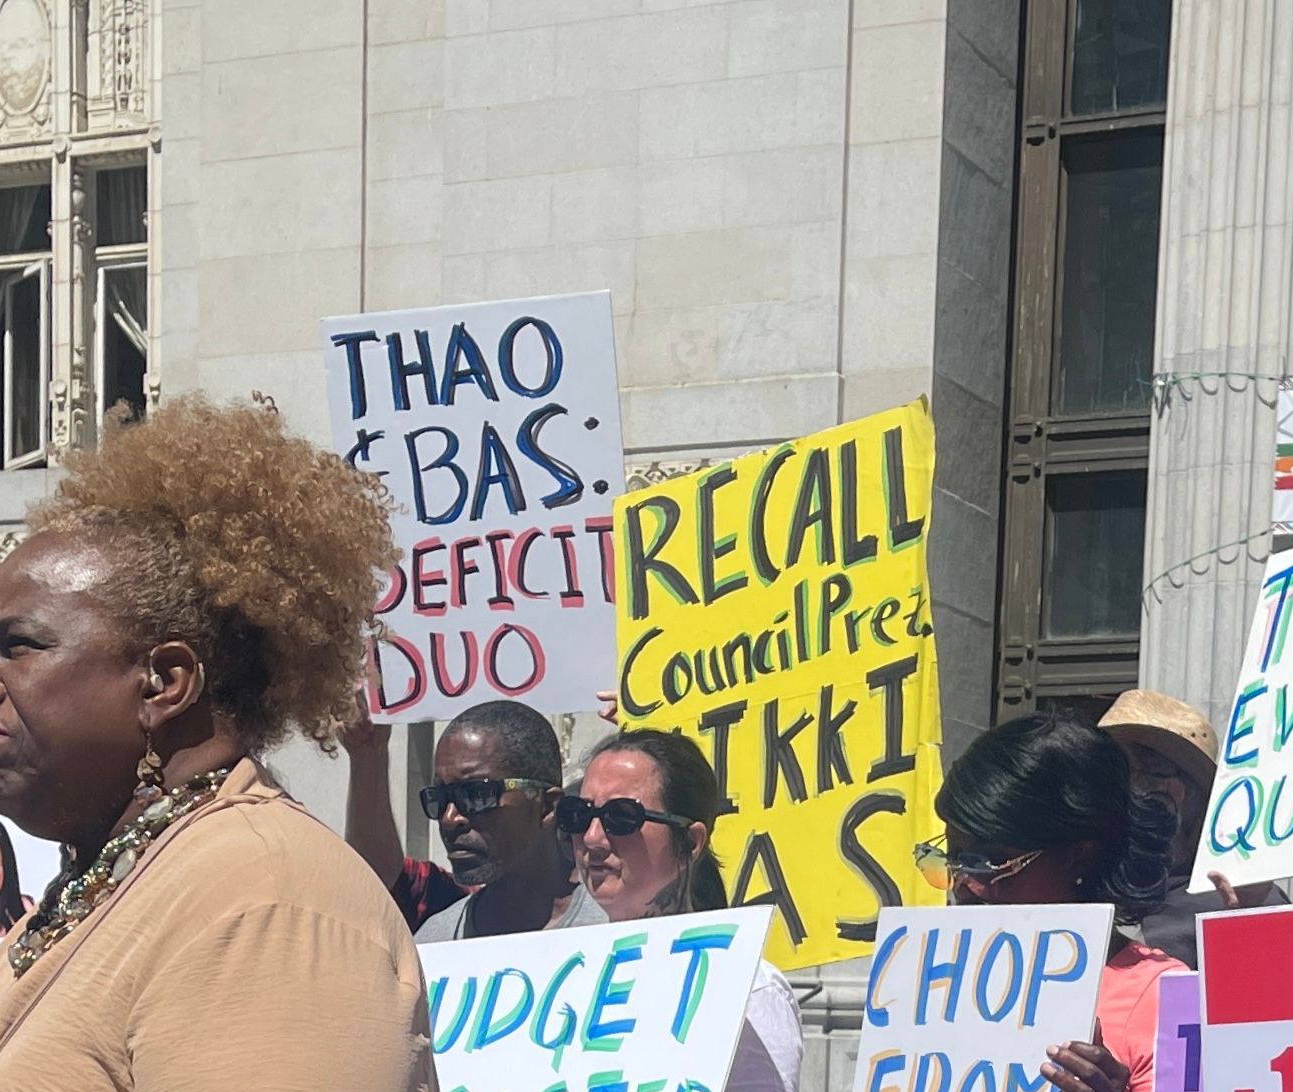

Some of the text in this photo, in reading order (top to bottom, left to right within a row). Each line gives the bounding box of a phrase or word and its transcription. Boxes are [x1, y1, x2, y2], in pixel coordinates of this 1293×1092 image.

[330, 316, 563, 420] THAO
[404, 402, 610, 525] BAS:
[624, 426, 926, 621] RECALL
[361, 622, 546, 715] DUO
[620, 577, 809, 721] Council
[696, 653, 919, 817] IKKI
[729, 793, 906, 951] AS
[866, 926, 1088, 1030] CHOP
